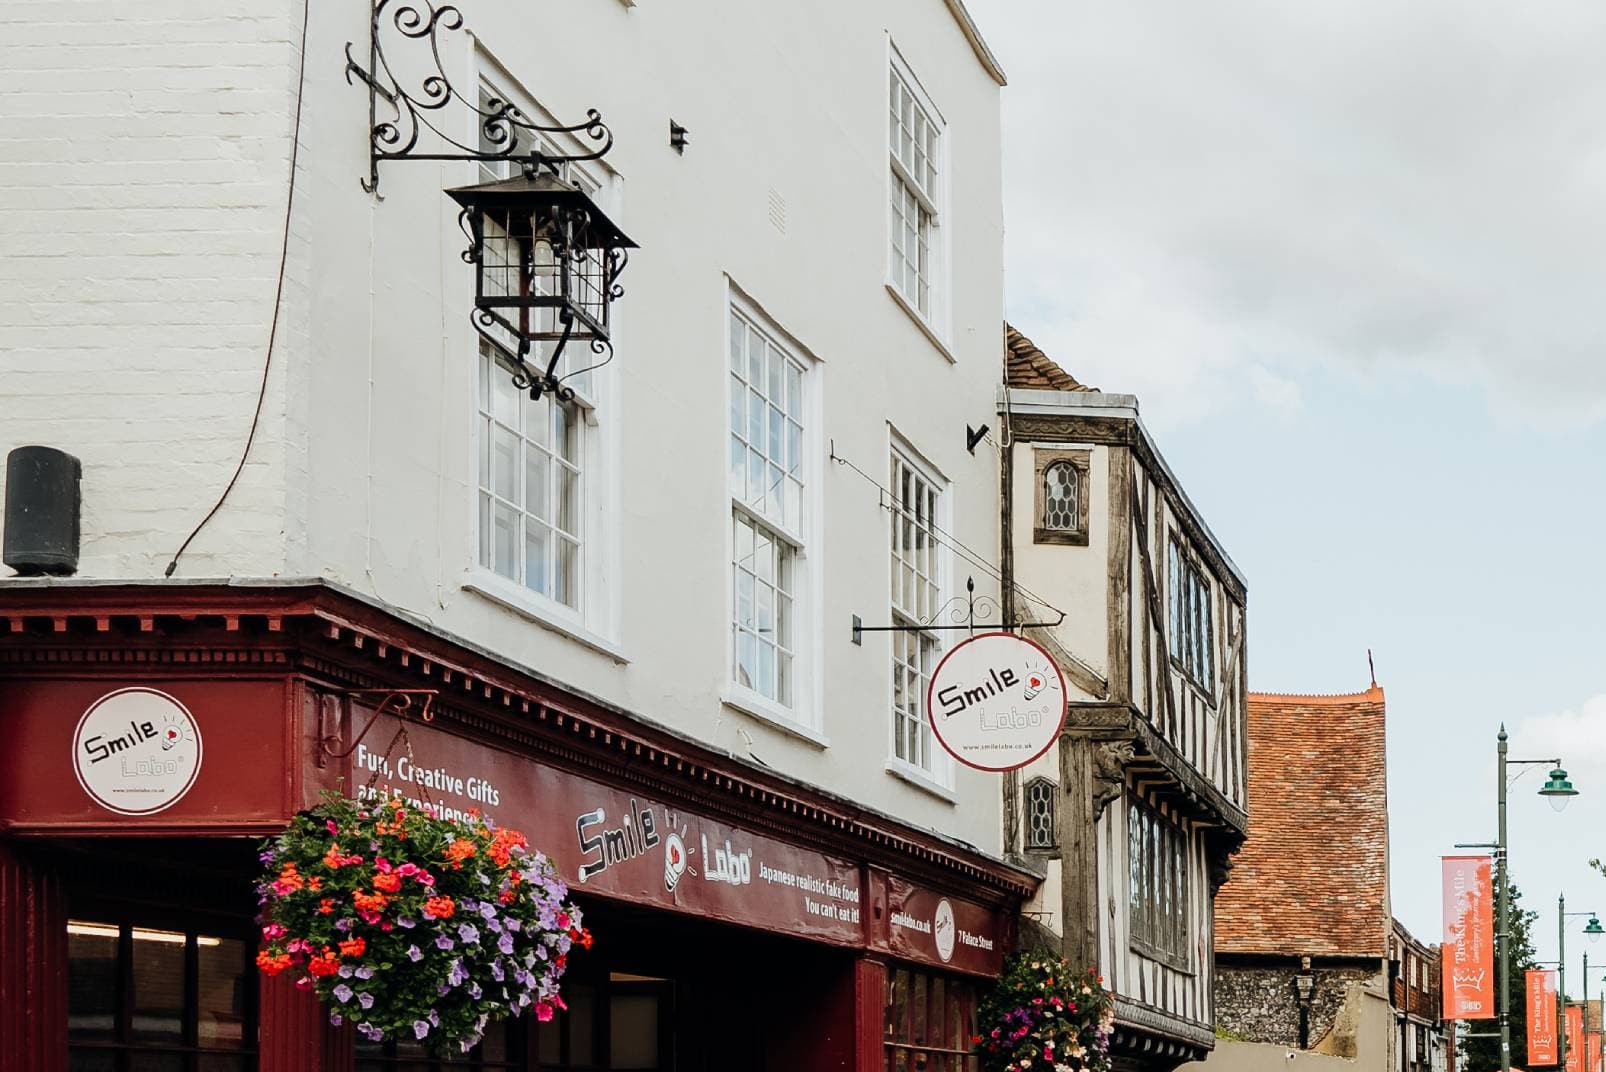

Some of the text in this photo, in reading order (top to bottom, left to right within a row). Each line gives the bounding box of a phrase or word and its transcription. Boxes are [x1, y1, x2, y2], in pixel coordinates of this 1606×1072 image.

[938, 668, 1020, 719] Smile
[84, 720, 159, 766] Smile
[358, 743, 500, 807] Fun, Creative Gifts
[576, 798, 751, 885] Smile Labo
[759, 861, 859, 903] Japanese realistic fake food
[805, 896, 860, 924] You can't eat it!
[962, 931, 979, 947] Palace
